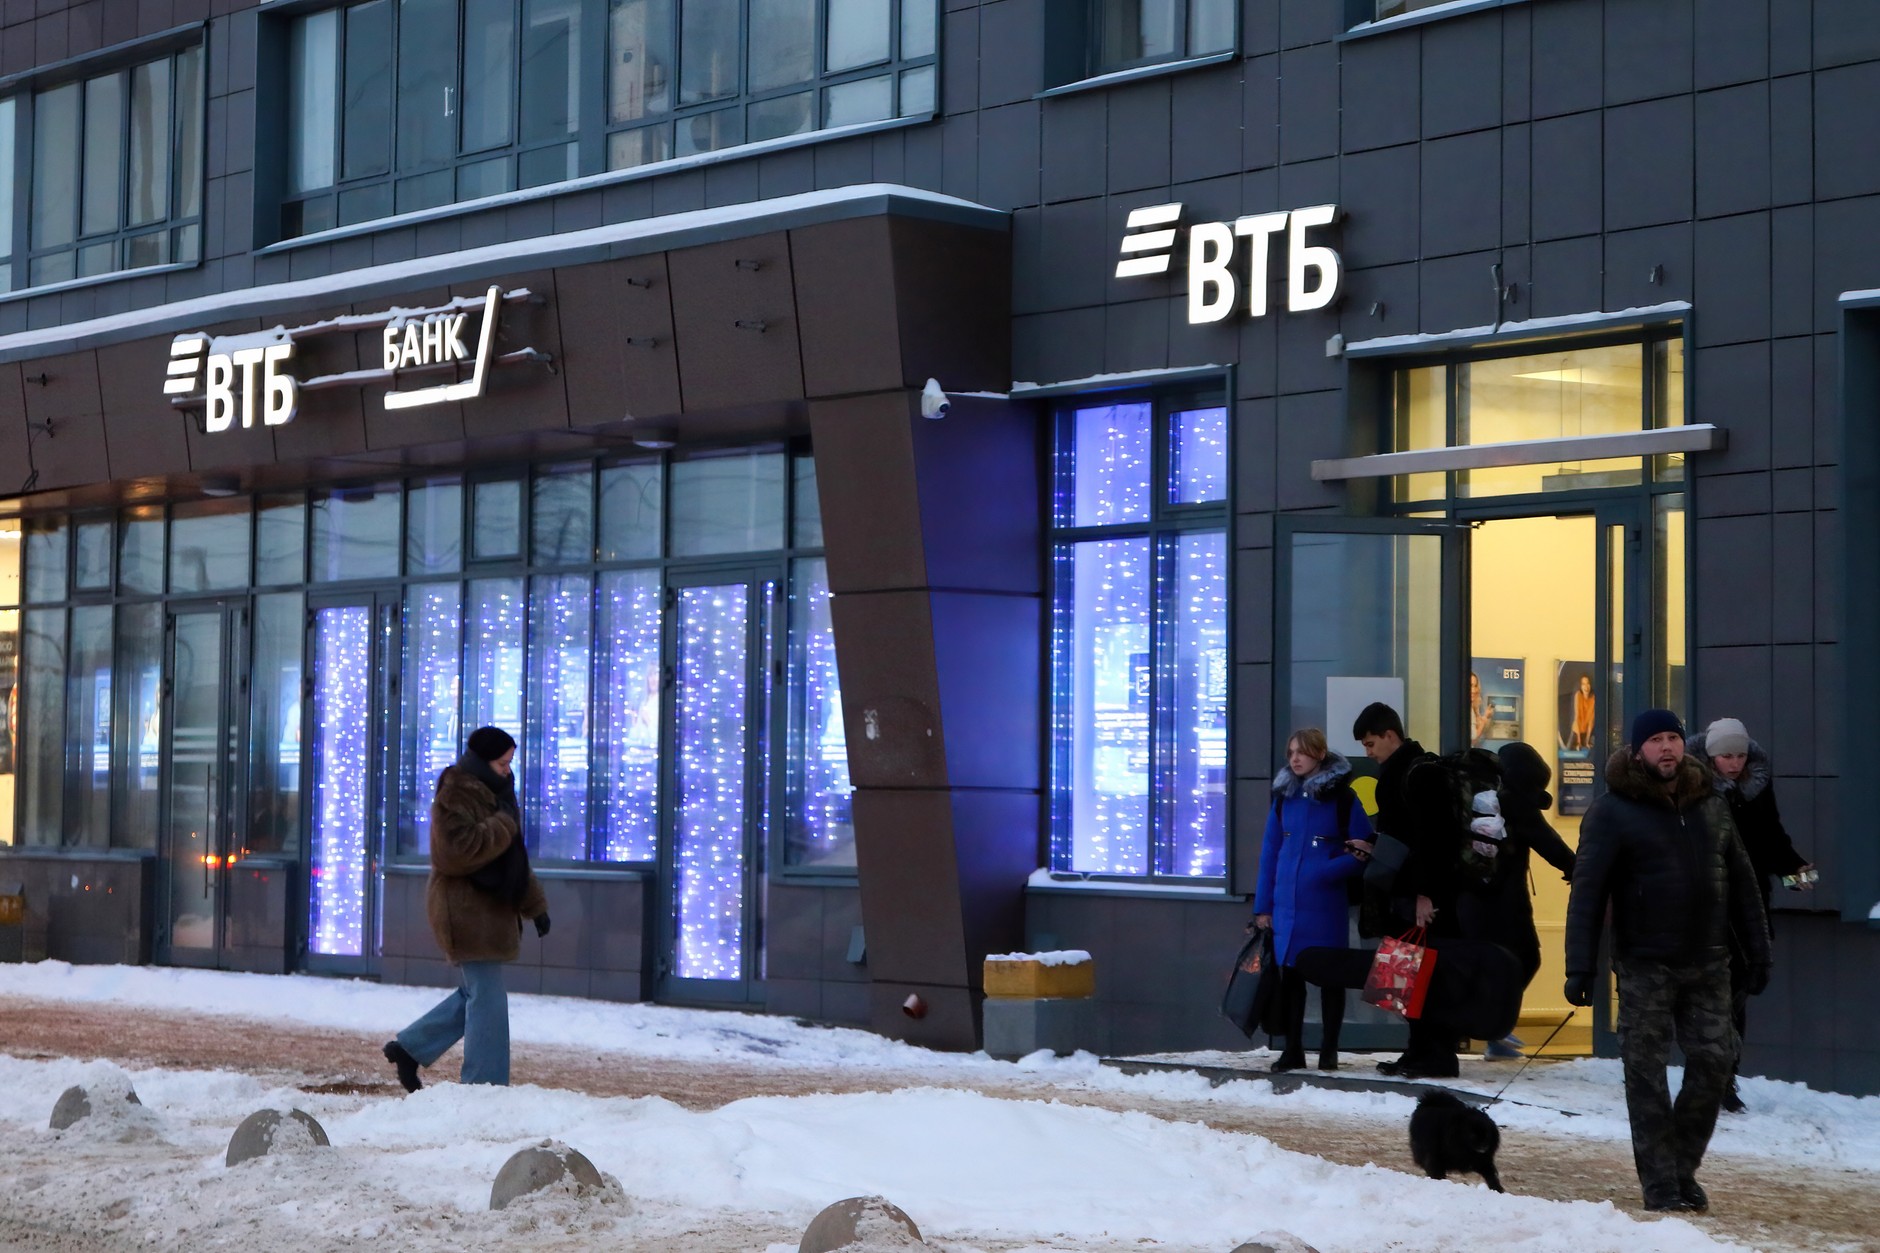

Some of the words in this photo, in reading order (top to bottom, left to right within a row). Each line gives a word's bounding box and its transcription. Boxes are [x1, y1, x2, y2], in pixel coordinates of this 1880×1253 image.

[1187, 204, 1341, 325] ВТБ
[206, 343, 297, 433] ВТБ
[383, 314, 469, 369] БАНК
[1503, 669, 1520, 680] ВТБ
